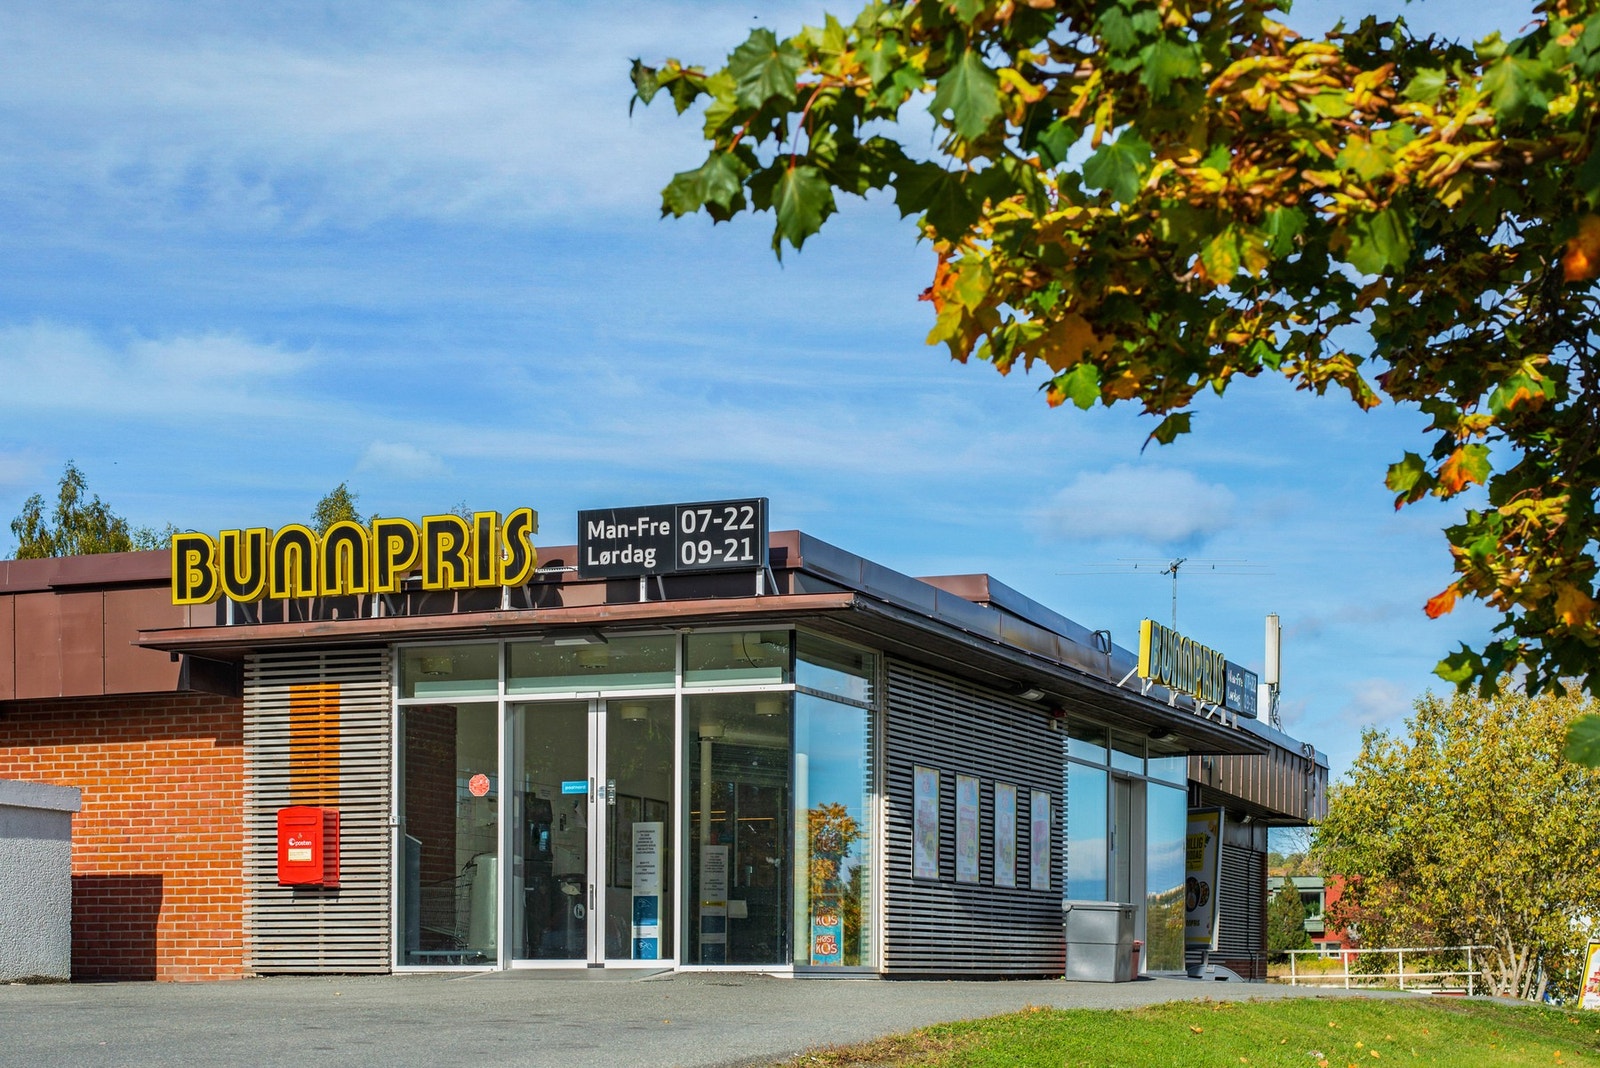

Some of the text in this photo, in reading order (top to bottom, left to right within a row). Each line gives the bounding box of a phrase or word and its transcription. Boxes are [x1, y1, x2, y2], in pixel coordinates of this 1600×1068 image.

[587, 505, 754, 540] Man-Fre 07-22
[172, 508, 537, 605] BUNNPRIS
[587, 537, 754, 568] Lørdag 09-21
[1147, 619, 1225, 706] BUNNPRIS
[815, 943, 838, 955] KOS
